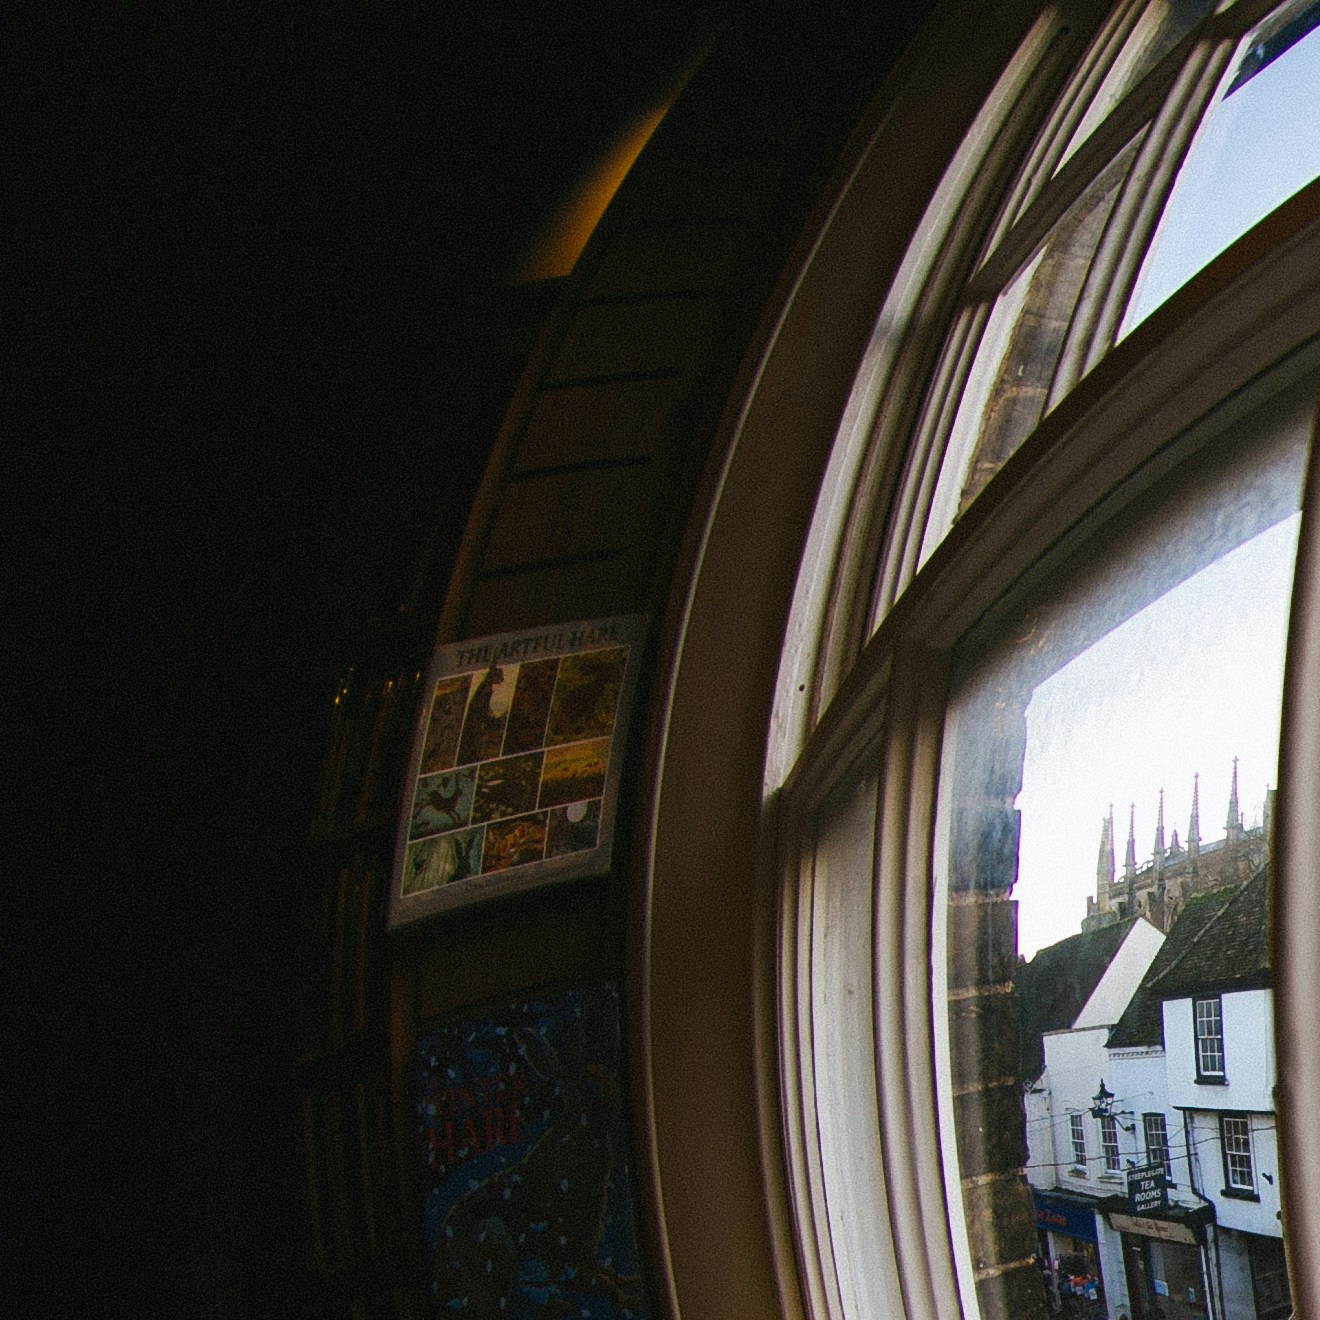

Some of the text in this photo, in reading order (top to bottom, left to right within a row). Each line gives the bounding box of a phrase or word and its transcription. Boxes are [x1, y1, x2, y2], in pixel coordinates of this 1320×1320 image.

[494, 631, 564, 659] ARTFUL
[1140, 1180, 1155, 1190] TEA
[1135, 1189, 1161, 1202] ROOMS
[1137, 1200, 1161, 1211] GALLERY
